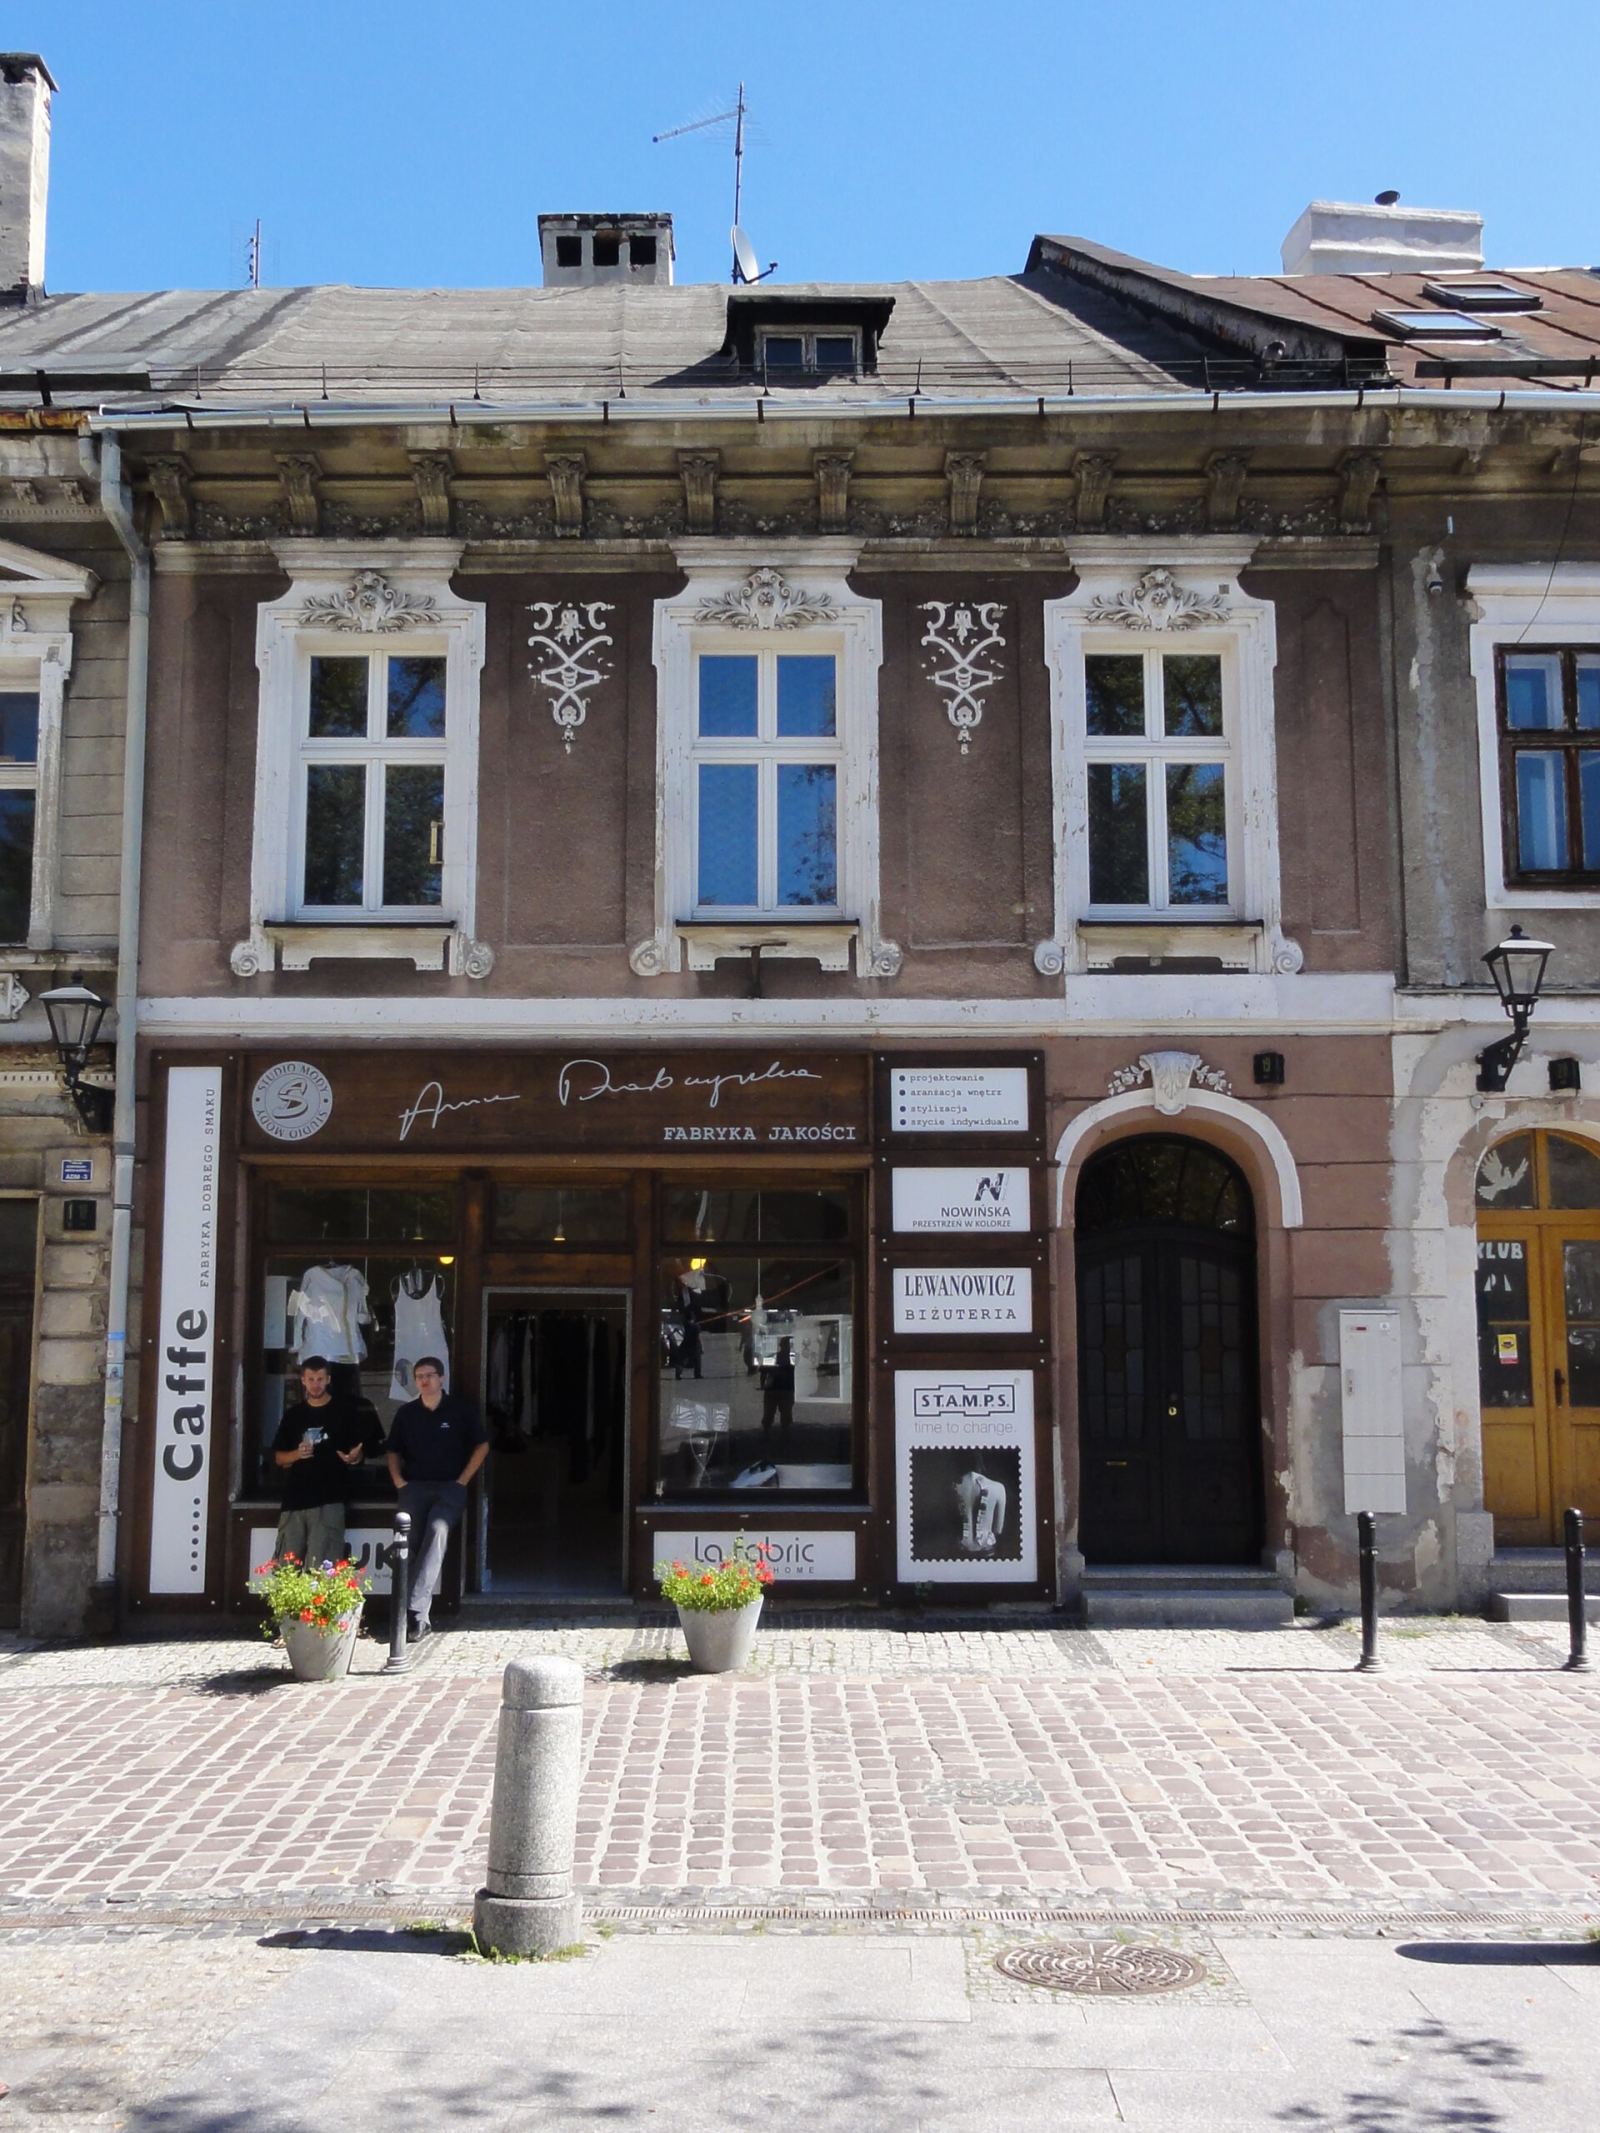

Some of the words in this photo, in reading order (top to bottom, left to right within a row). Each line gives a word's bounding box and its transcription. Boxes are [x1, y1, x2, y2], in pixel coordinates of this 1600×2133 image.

[257, 1063, 296, 1091] STUDIO
[300, 1065, 328, 1093] MODY
[910, 1074, 985, 1083] projektowanie
[910, 1088, 962, 1098] aranżacja
[967, 1088, 1002, 1098] wnętrz
[205, 1088, 216, 1135] SMAKU
[910, 1105, 968, 1114] stylizacja
[256, 1110, 283, 1137] MODY
[289, 1111, 328, 1139] STUDIO
[663, 1126, 757, 1141] FABRYKA
[768, 1122, 857, 1141] JAKOŚCI
[910, 1119, 945, 1127] szycie
[951, 1118, 1020, 1127] indywidualne
[202, 1144, 213, 1212] DOBREGO
[941, 1204, 1011, 1217] NOWIŃSKA
[199, 1220, 211, 1288] FABRYKA
[904, 1274, 1016, 1297] LEWANOWICZ
[905, 1306, 1017, 1320] BIŻUTERIA
[162, 1309, 208, 1482] Caffe
[914, 1420, 942, 1434] time
[946, 1421, 960, 1434] to
[963, 1420, 1017, 1436] change.
[694, 1536, 723, 1563] la
[732, 1536, 815, 1563] fabric
[772, 1566, 816, 1575] HOME
